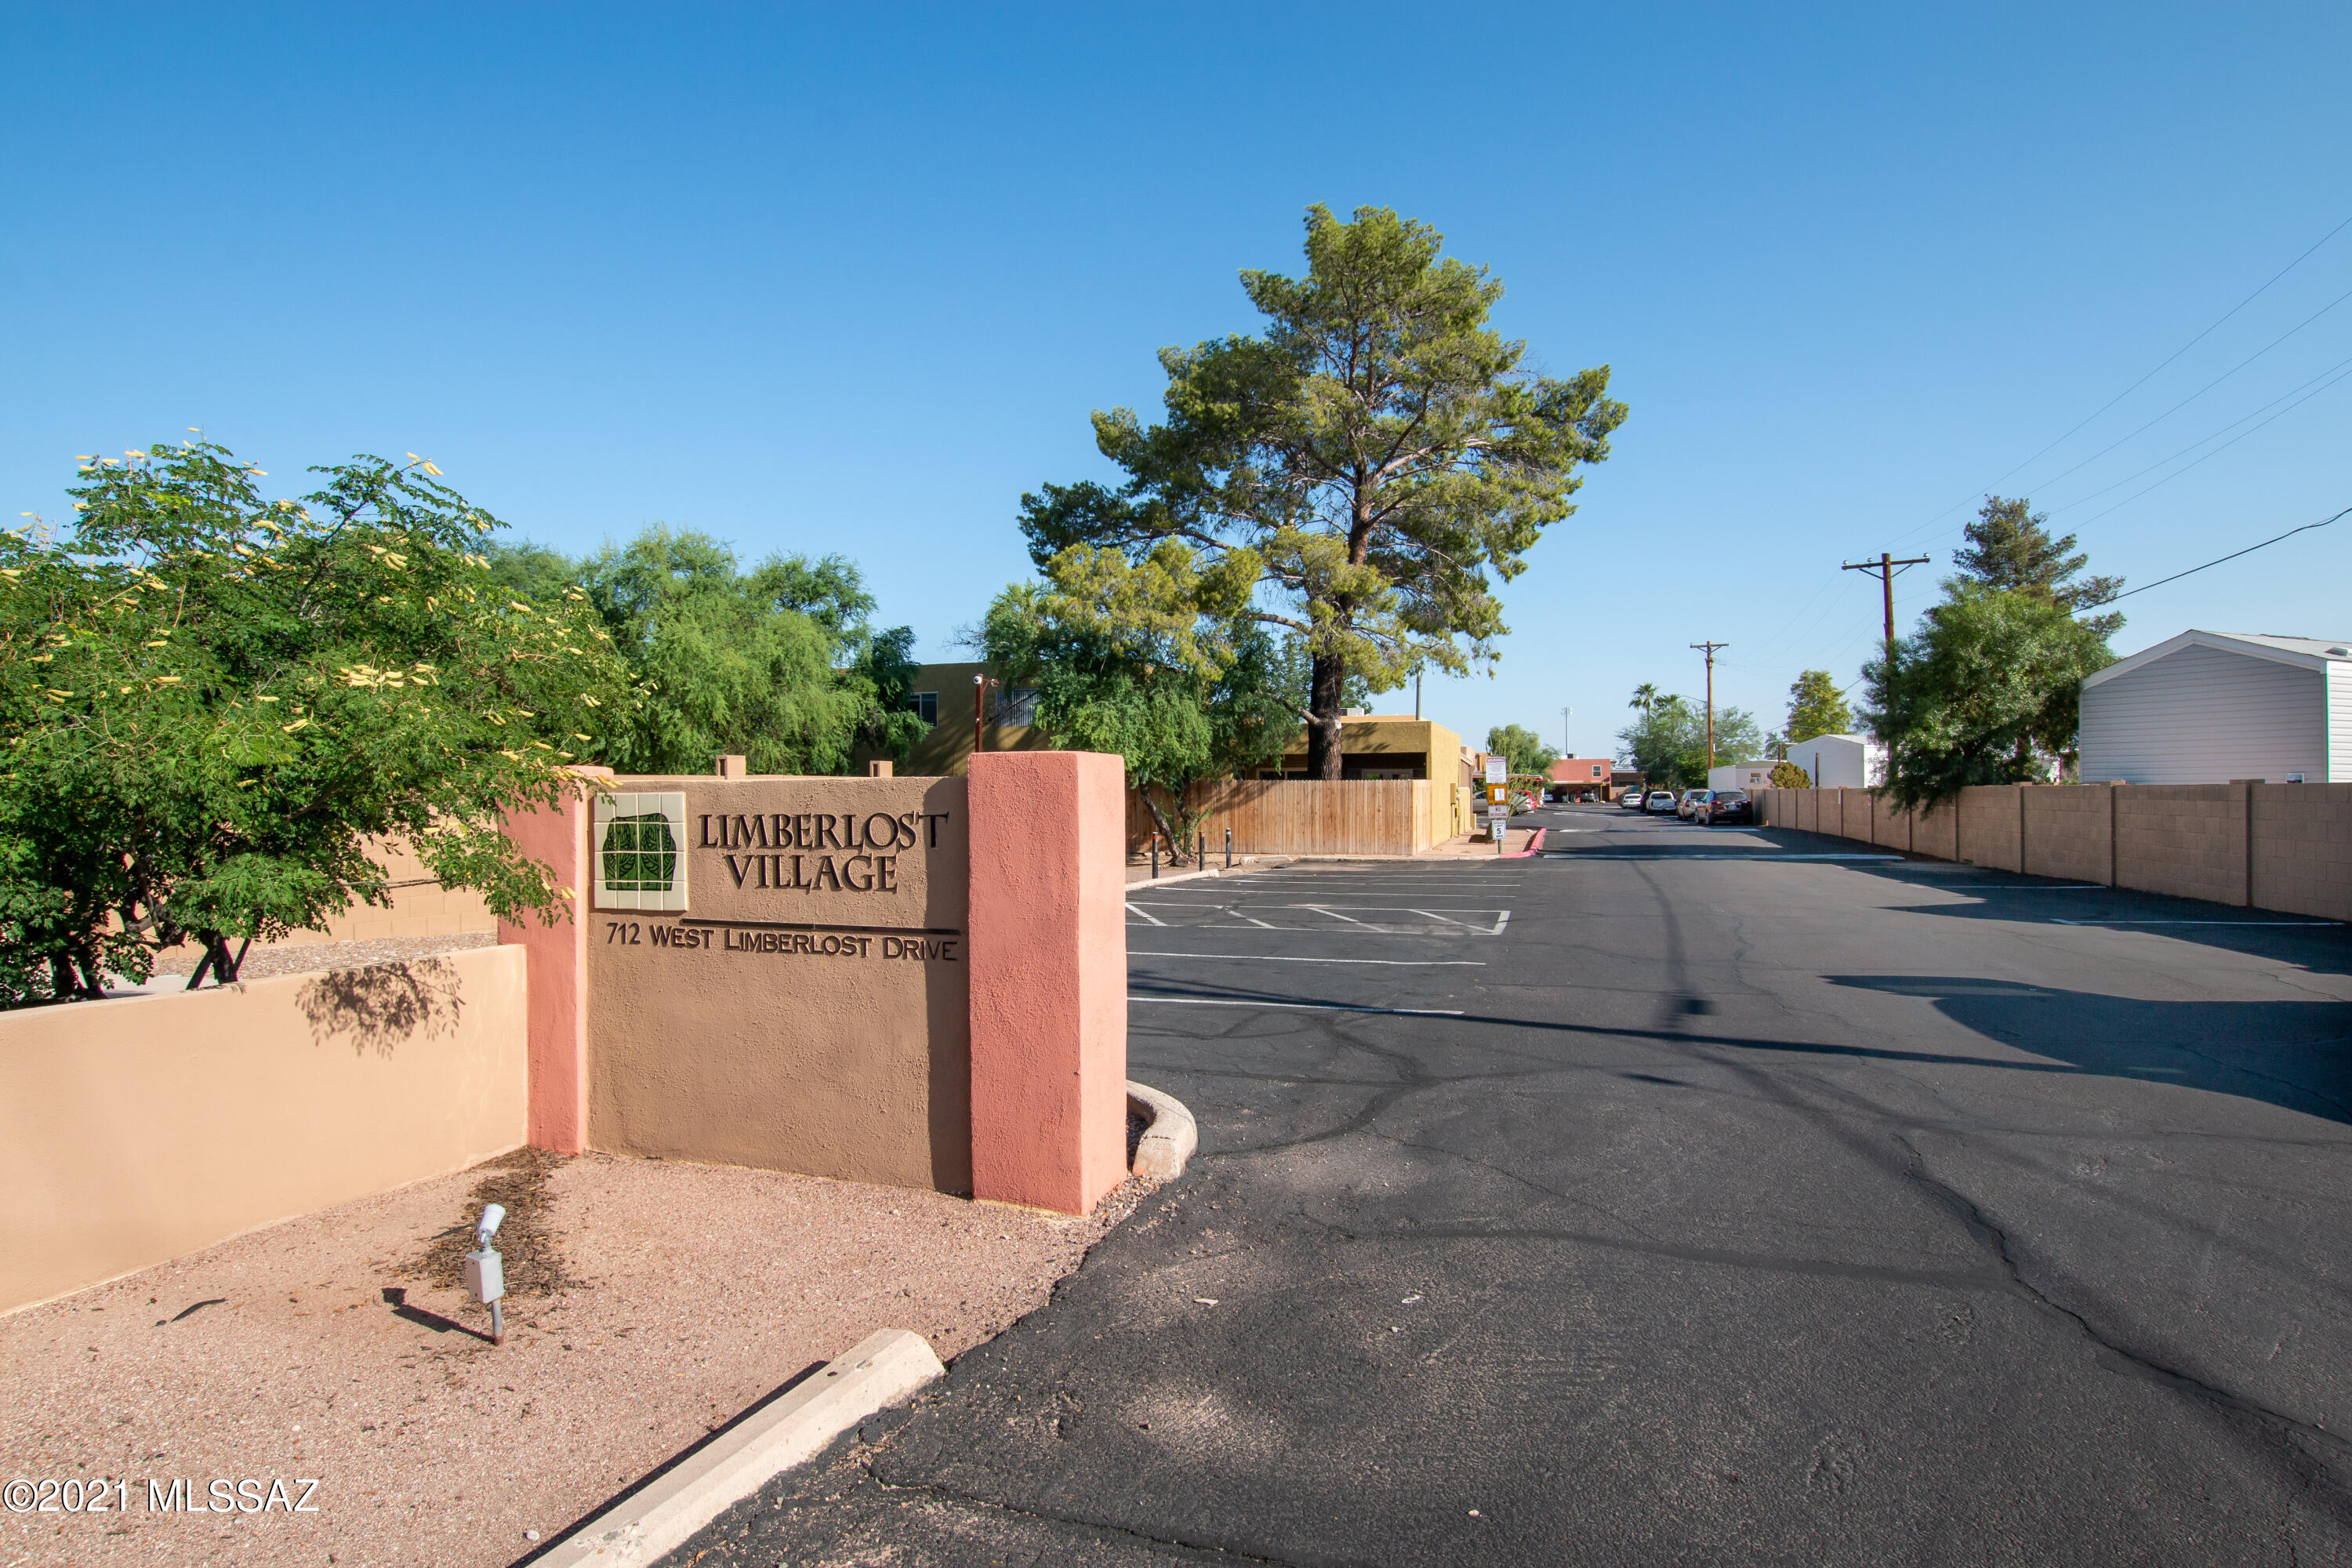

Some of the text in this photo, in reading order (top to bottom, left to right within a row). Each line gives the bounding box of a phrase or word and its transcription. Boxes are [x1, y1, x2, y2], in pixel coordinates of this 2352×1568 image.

[698, 811, 949, 850] LIMBERLOST
[724, 854, 898, 892] VILLAGE
[606, 922, 958, 961] 712 WEST LIMBERLOST DRIVE
